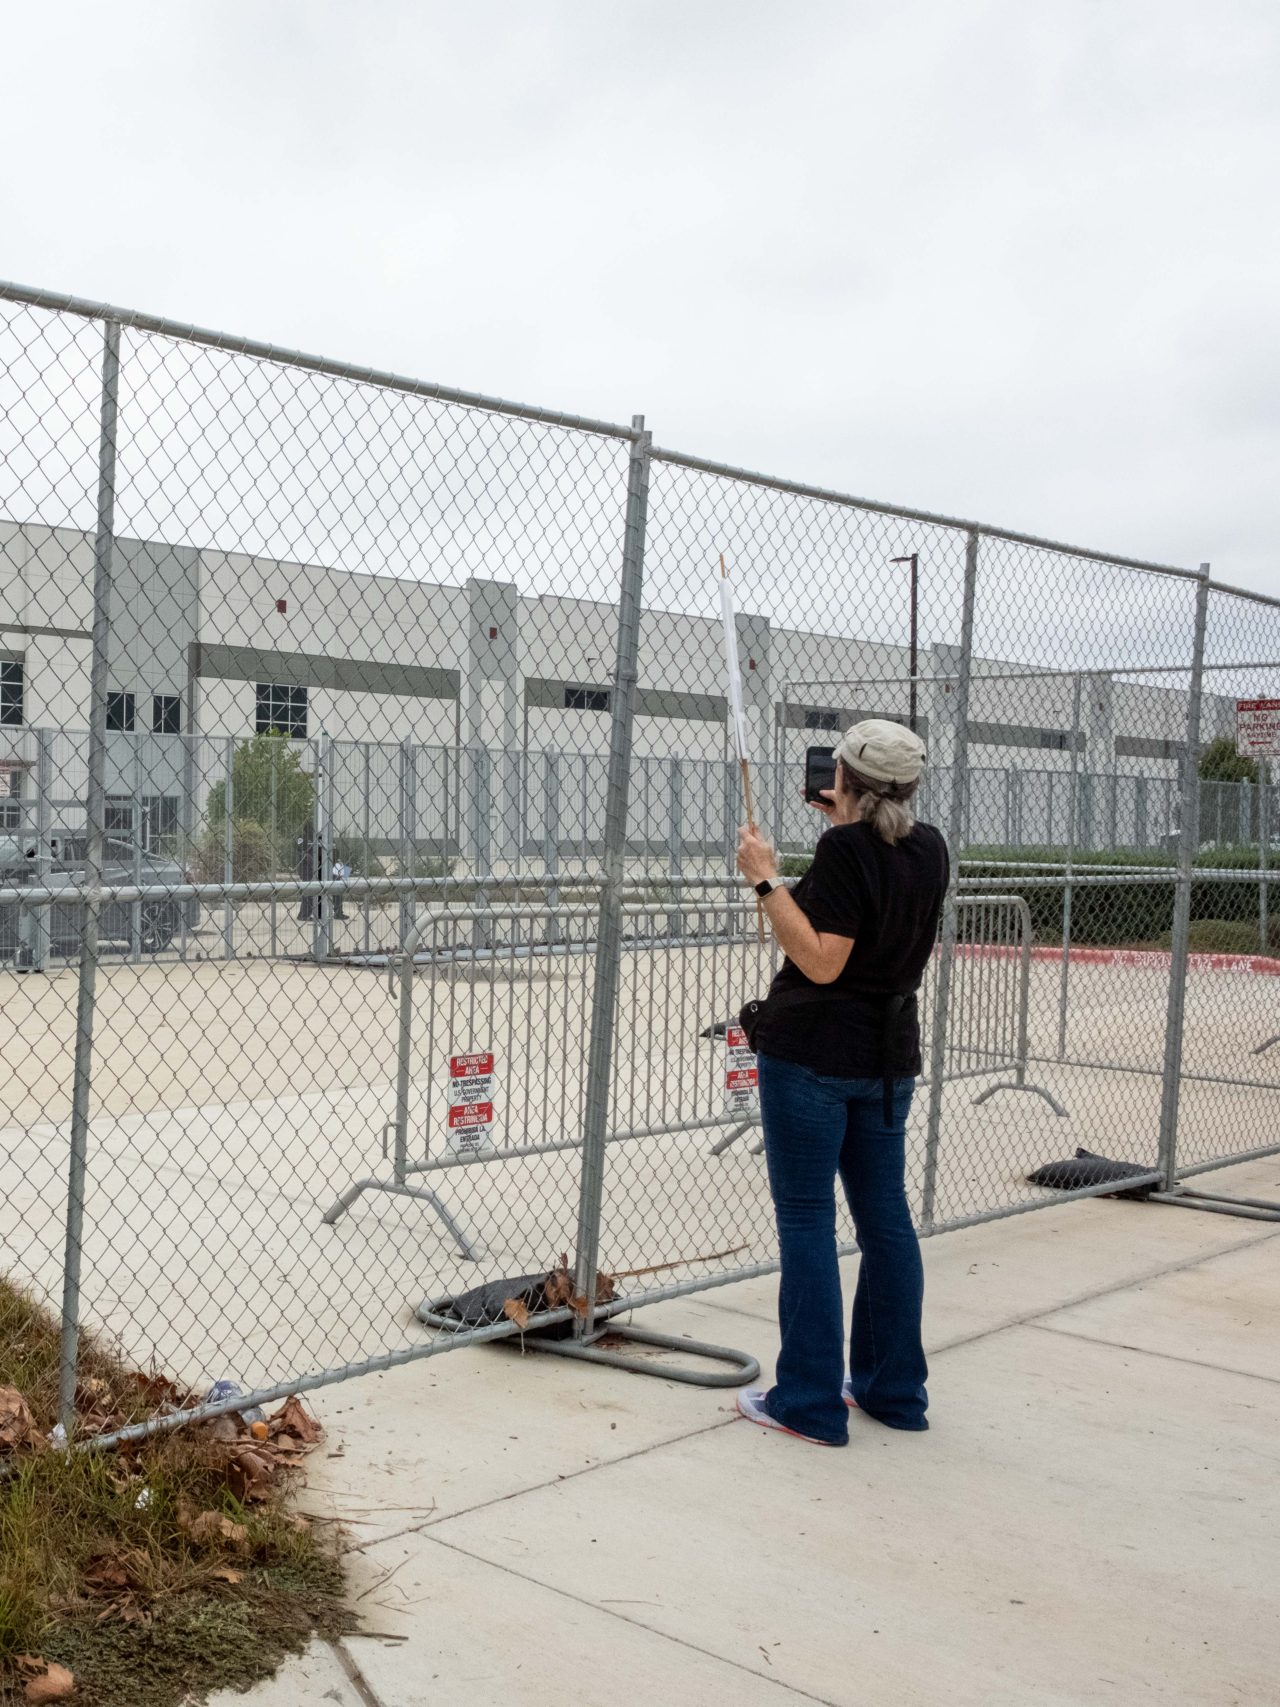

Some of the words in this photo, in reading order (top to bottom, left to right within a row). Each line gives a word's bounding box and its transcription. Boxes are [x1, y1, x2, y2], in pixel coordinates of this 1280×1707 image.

[1253, 713, 1268, 721] NO
[456, 1055, 488, 1067] RESTRICTED
[465, 1065, 480, 1076] AREA
[460, 1077, 492, 1087] TRESPASSING
